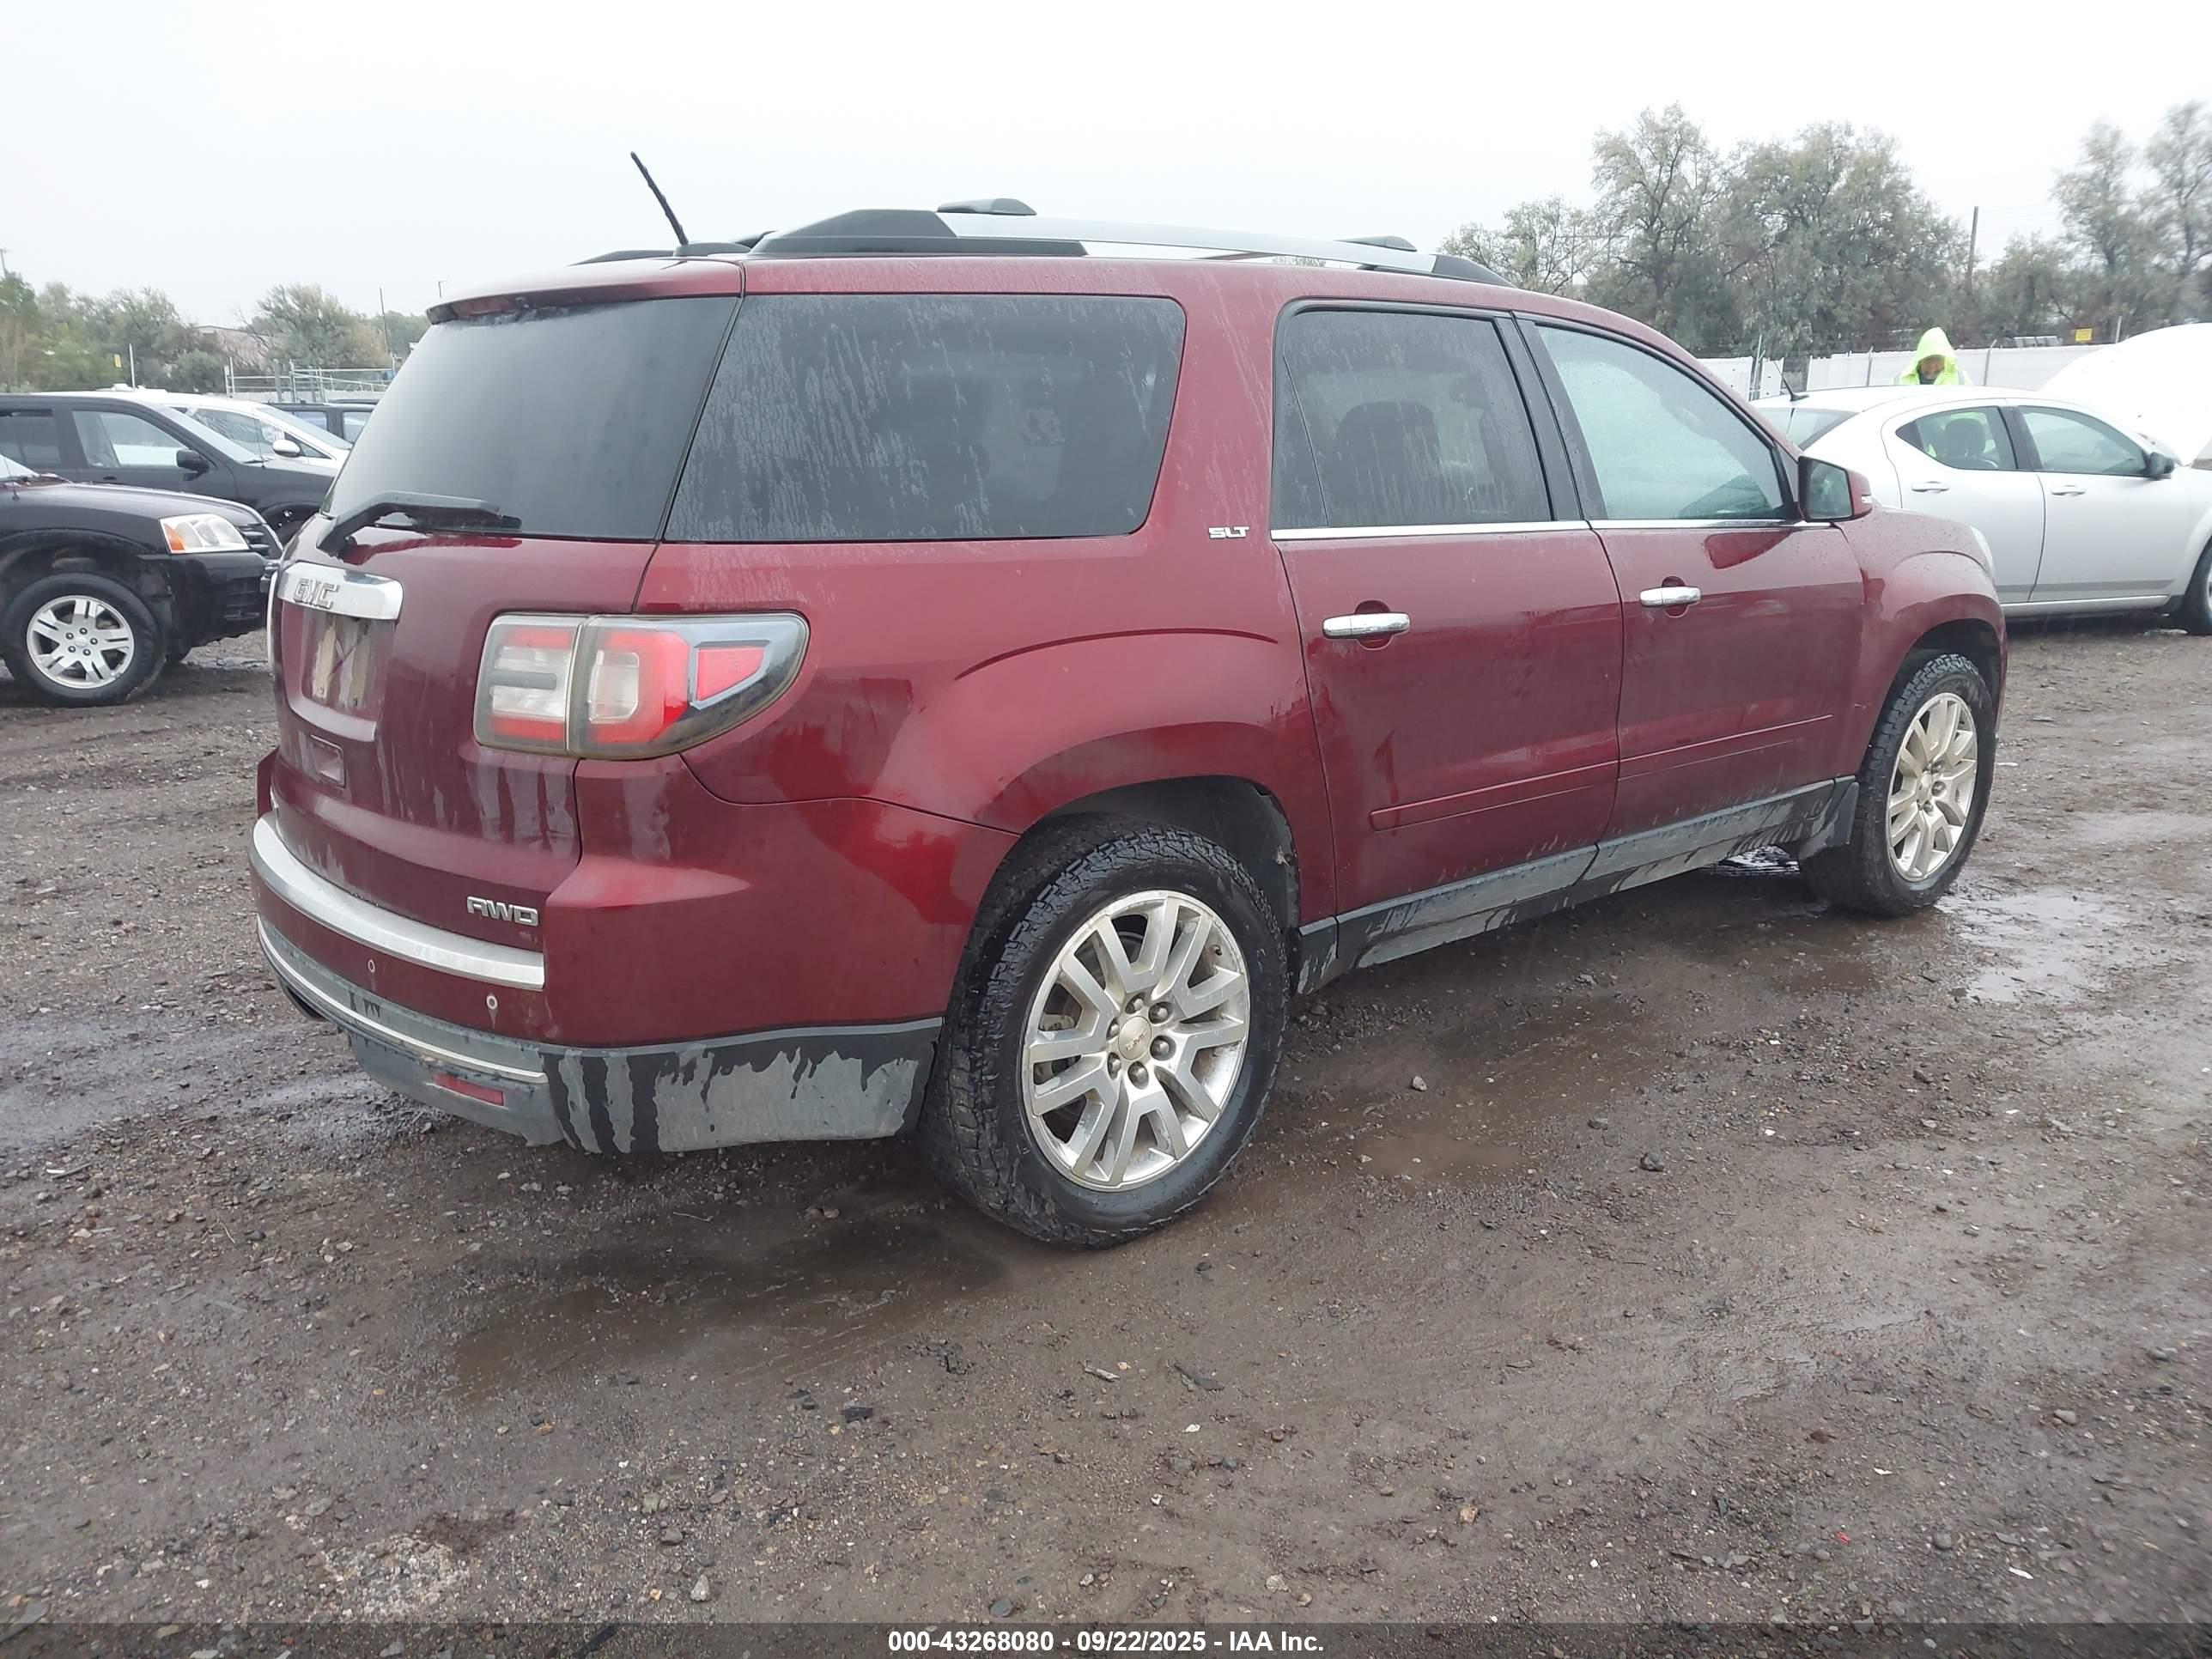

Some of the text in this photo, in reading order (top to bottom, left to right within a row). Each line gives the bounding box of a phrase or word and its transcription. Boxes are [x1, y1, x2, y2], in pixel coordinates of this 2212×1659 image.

[1208, 526, 1250, 539] SLT
[294, 577, 340, 610] GMC
[466, 895, 539, 927] AWD
